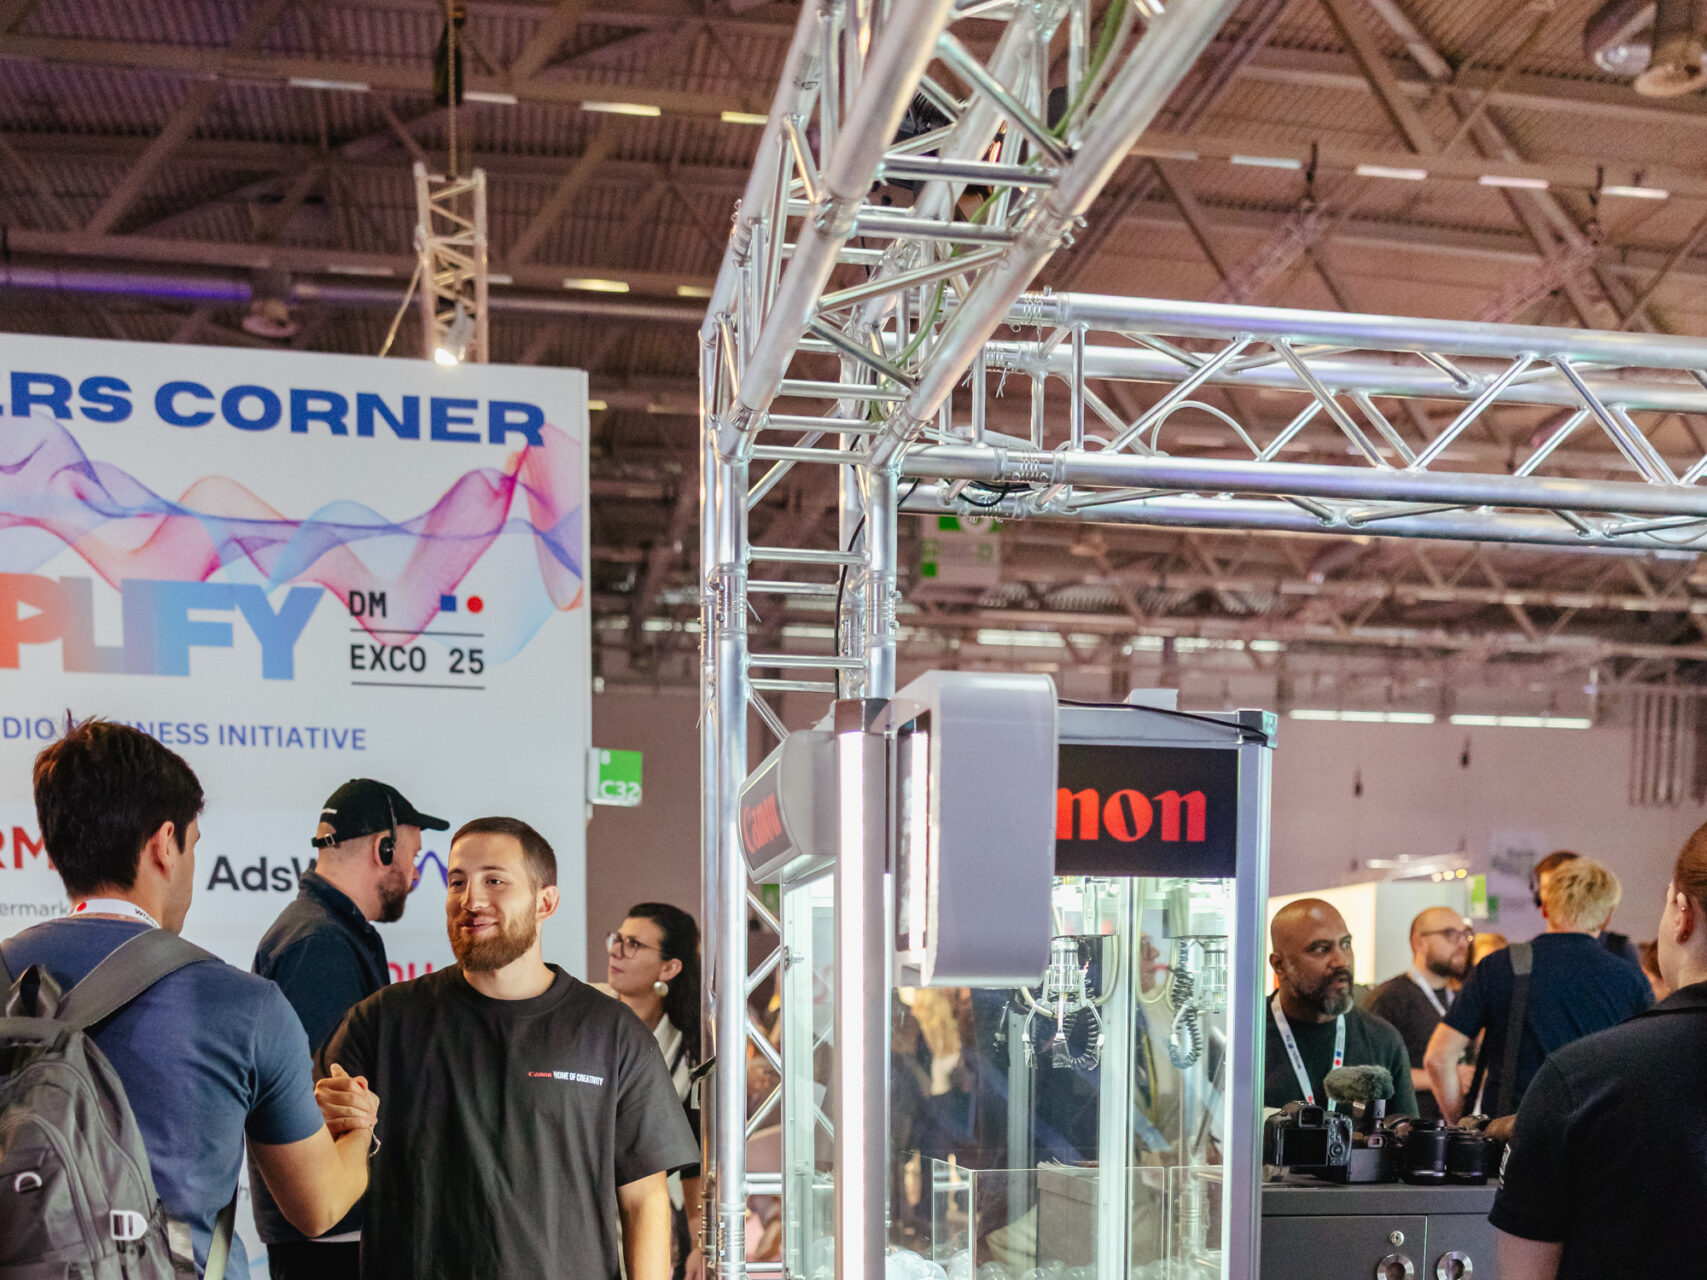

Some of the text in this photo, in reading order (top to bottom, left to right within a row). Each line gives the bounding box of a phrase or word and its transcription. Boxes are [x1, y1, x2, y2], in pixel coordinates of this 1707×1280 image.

[0, 371, 545, 447] RS CORNER
[349, 591, 387, 618] DM
[0, 572, 326, 681] PLIFY
[350, 645, 485, 674] EXCO 25
[2, 716, 56, 740] DIO
[218, 724, 367, 750] INITIATIVE
[600, 779, 642, 805] C32
[1056, 788, 1207, 842] non
